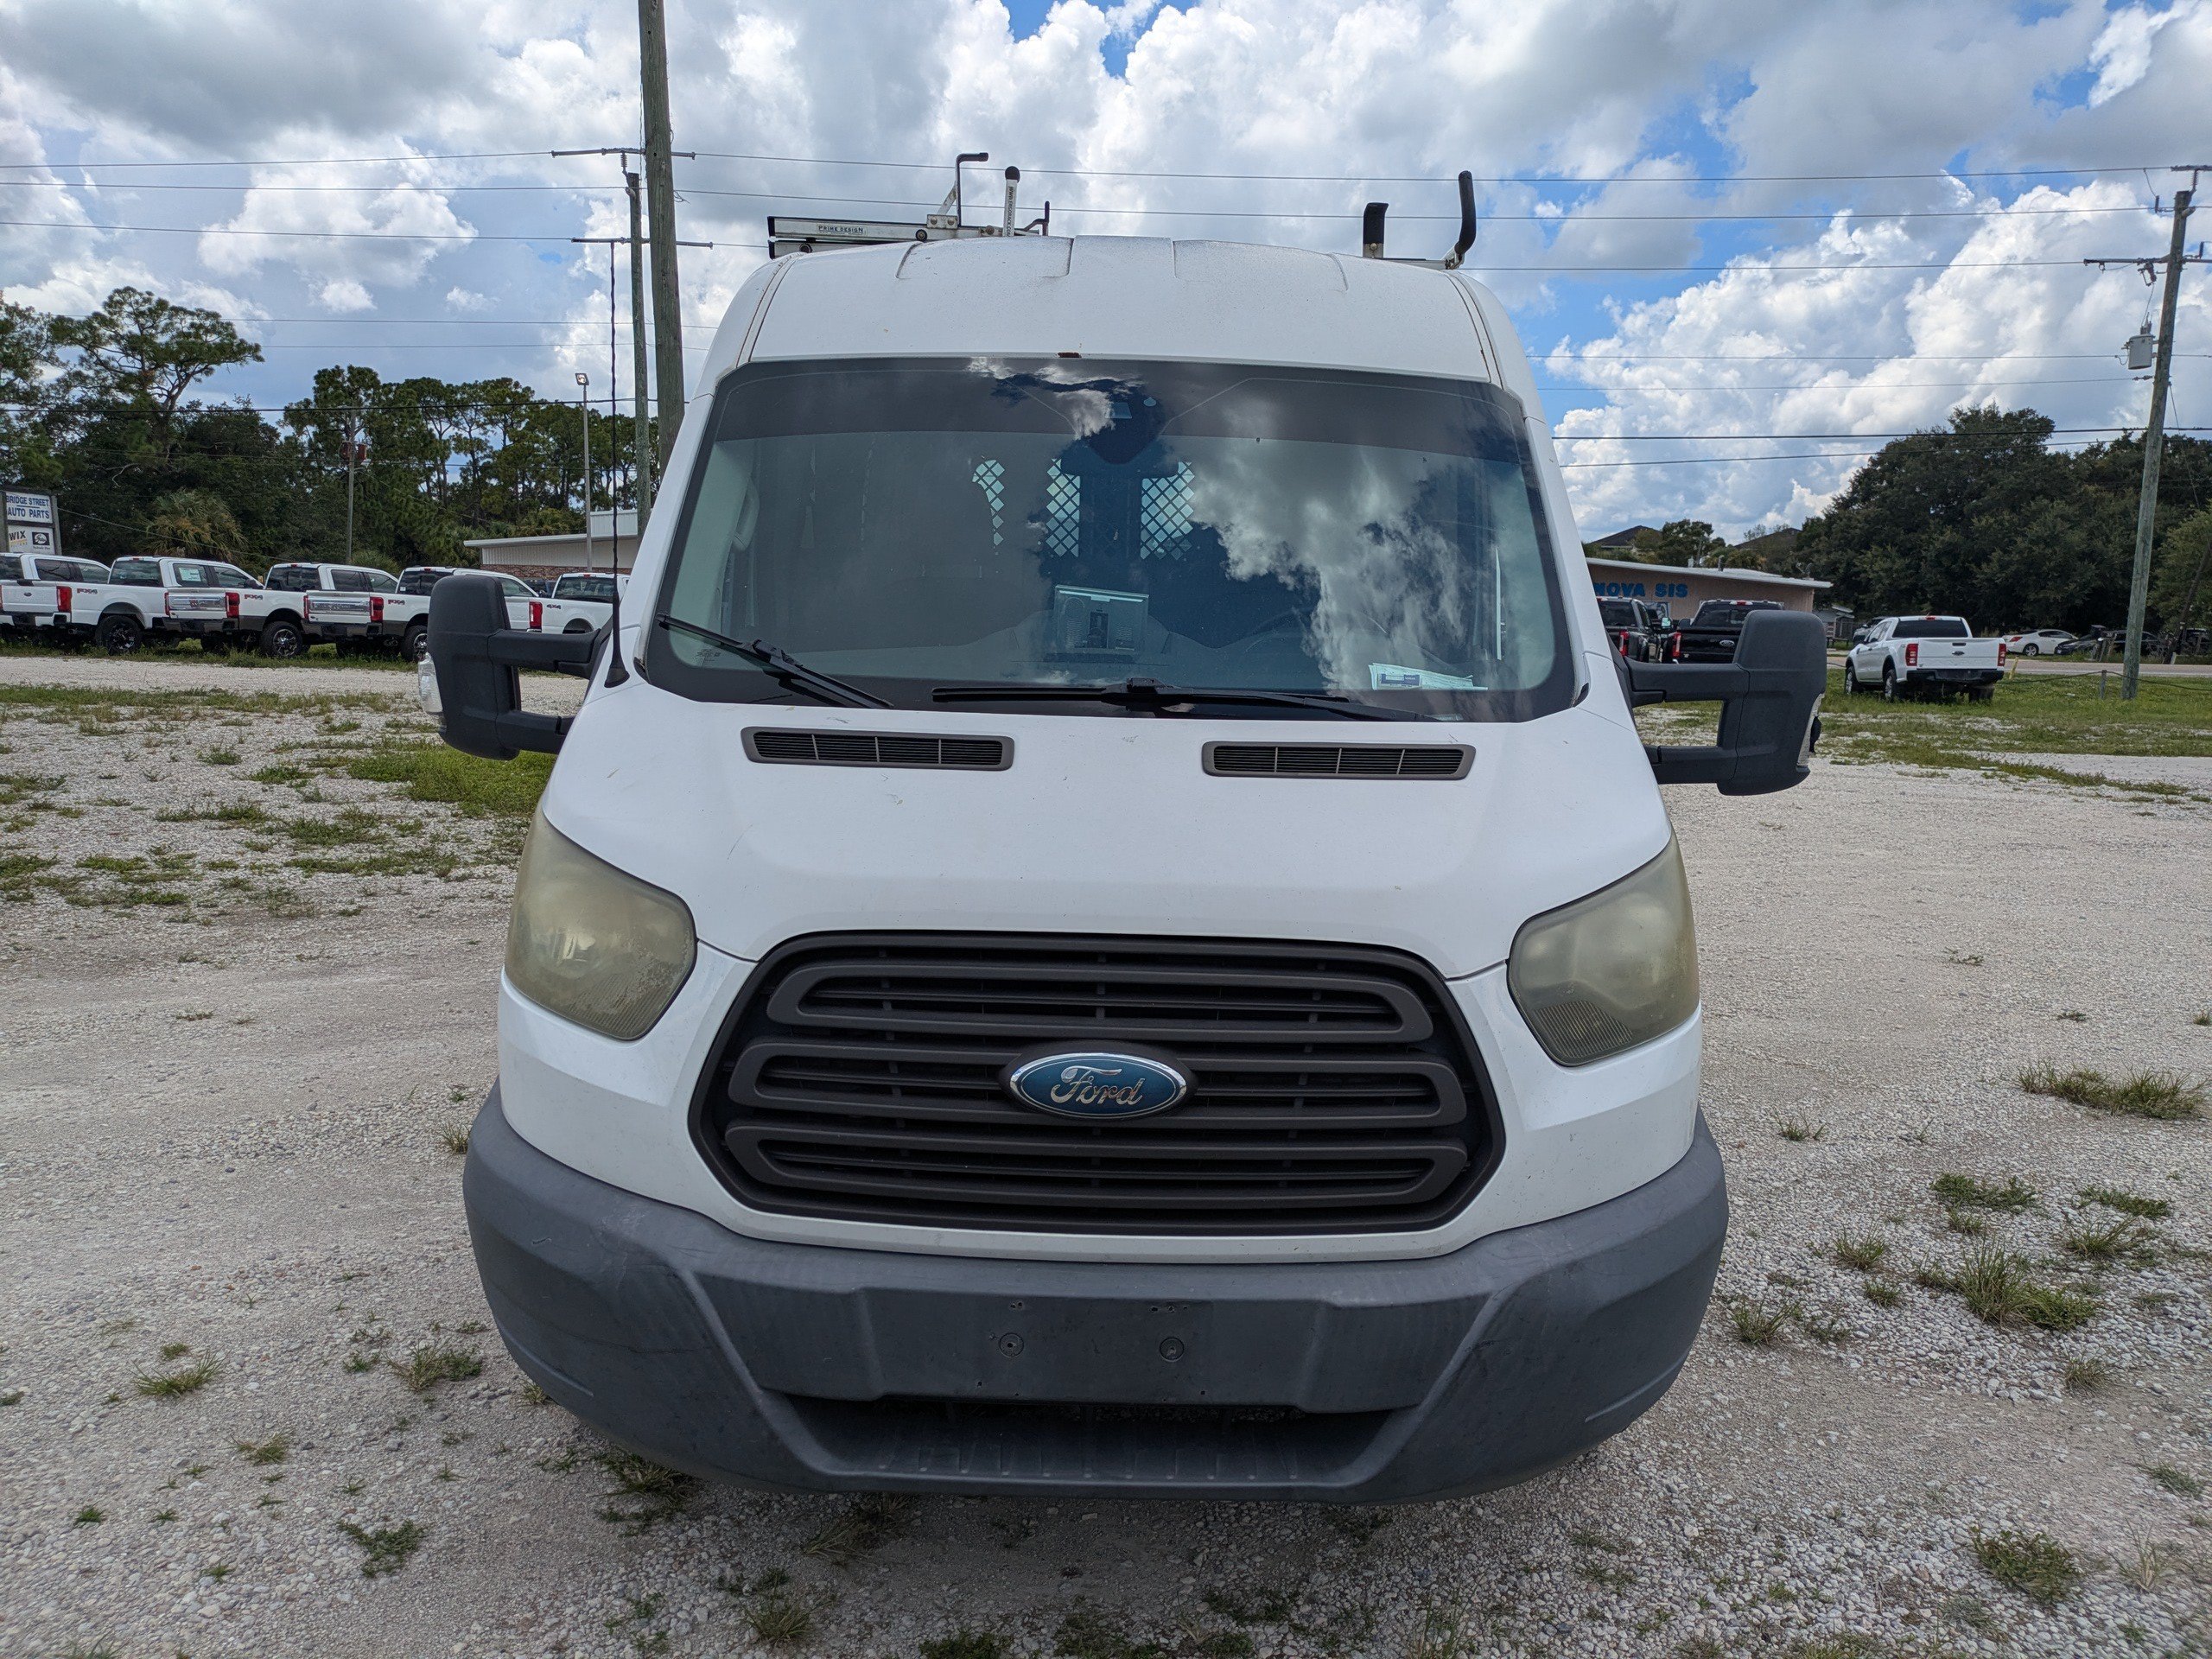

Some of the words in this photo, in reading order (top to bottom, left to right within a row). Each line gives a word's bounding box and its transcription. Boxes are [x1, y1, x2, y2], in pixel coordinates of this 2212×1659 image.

[6, 495, 27, 505] BRIDGE
[29, 498, 49, 507] STREET
[8, 507, 26, 518] AUTO
[29, 509, 50, 519] PARTS
[10, 531, 26, 541] WIX
[1655, 582, 1688, 597] SIS
[1050, 1065, 1146, 1106] Ford
